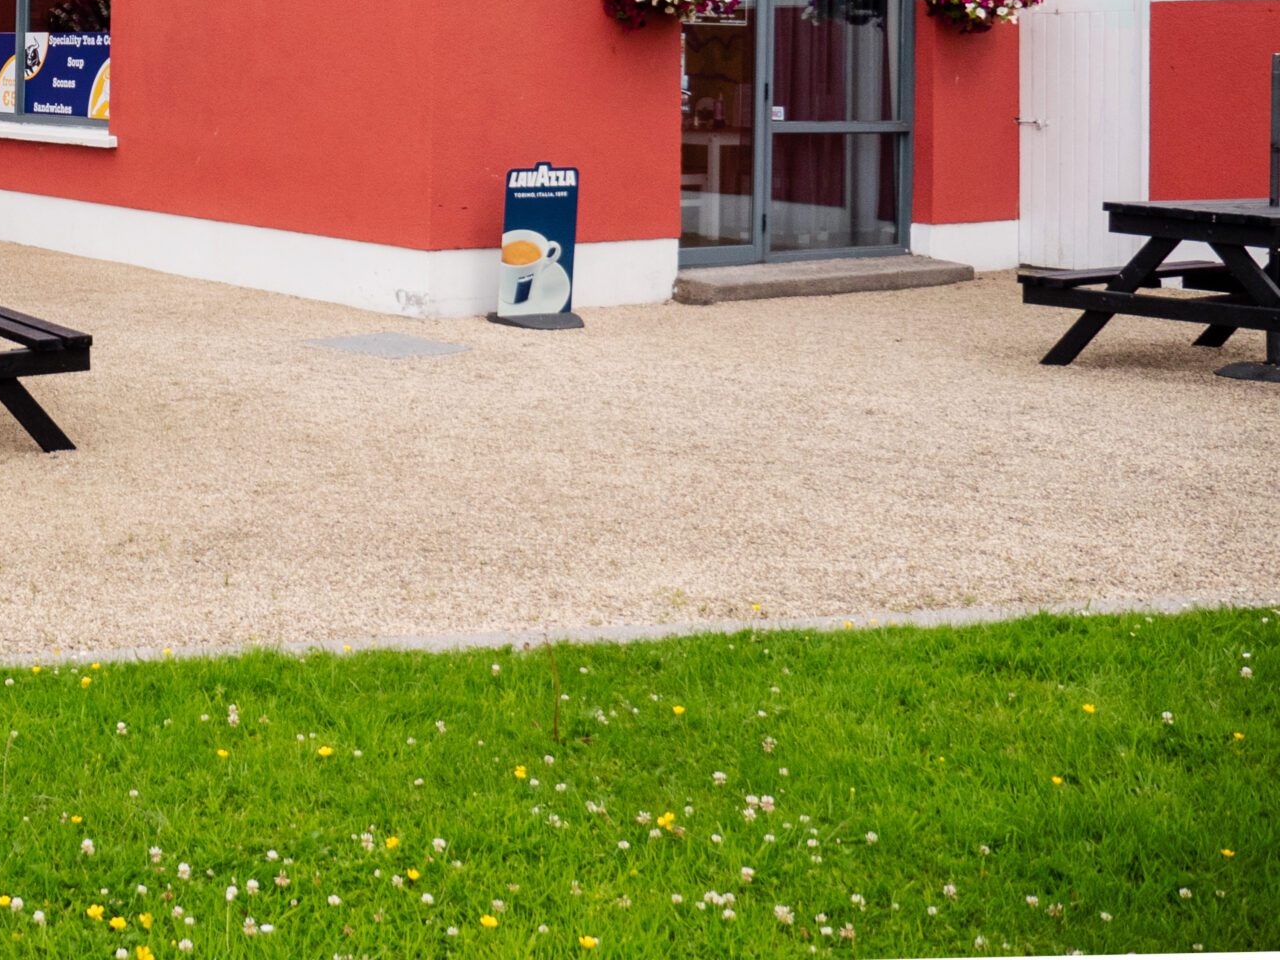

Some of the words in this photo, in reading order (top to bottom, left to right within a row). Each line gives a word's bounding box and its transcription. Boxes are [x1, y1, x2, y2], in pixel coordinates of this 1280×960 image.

[82, 35, 95, 45] Tea
[96, 35, 102, 45] &
[67, 56, 84, 69] Soup
[52, 77, 76, 88] Scones
[33, 102, 72, 114] Sandwiches
[509, 165, 576, 187] LAVAZZA
